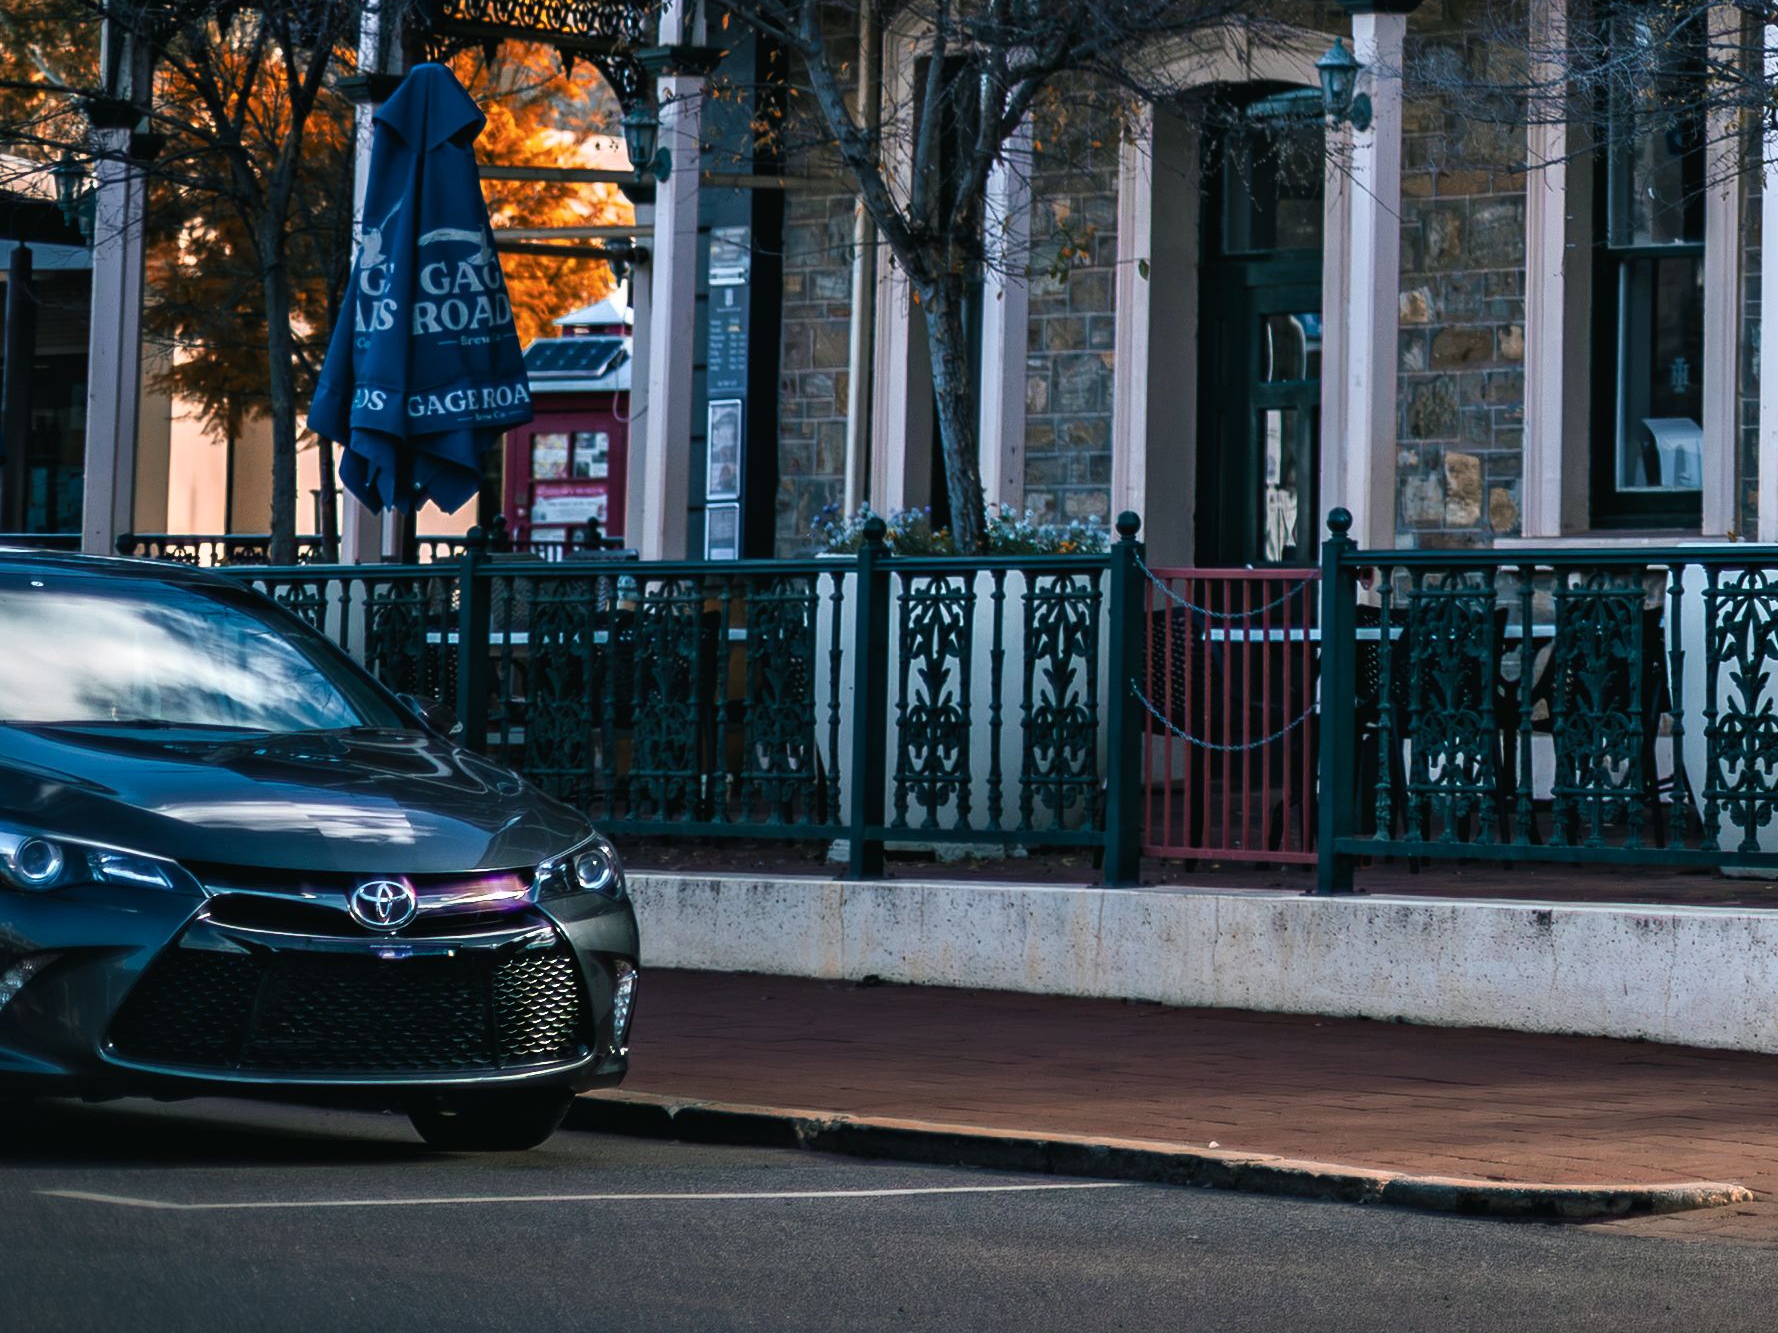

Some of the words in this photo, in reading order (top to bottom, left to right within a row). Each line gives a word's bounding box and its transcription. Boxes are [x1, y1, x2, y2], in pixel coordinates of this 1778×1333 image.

[420, 258, 501, 295] GAG
[412, 293, 513, 335] ROAD
[407, 389, 479, 417] GAGE
[482, 383, 531, 409] ROA
